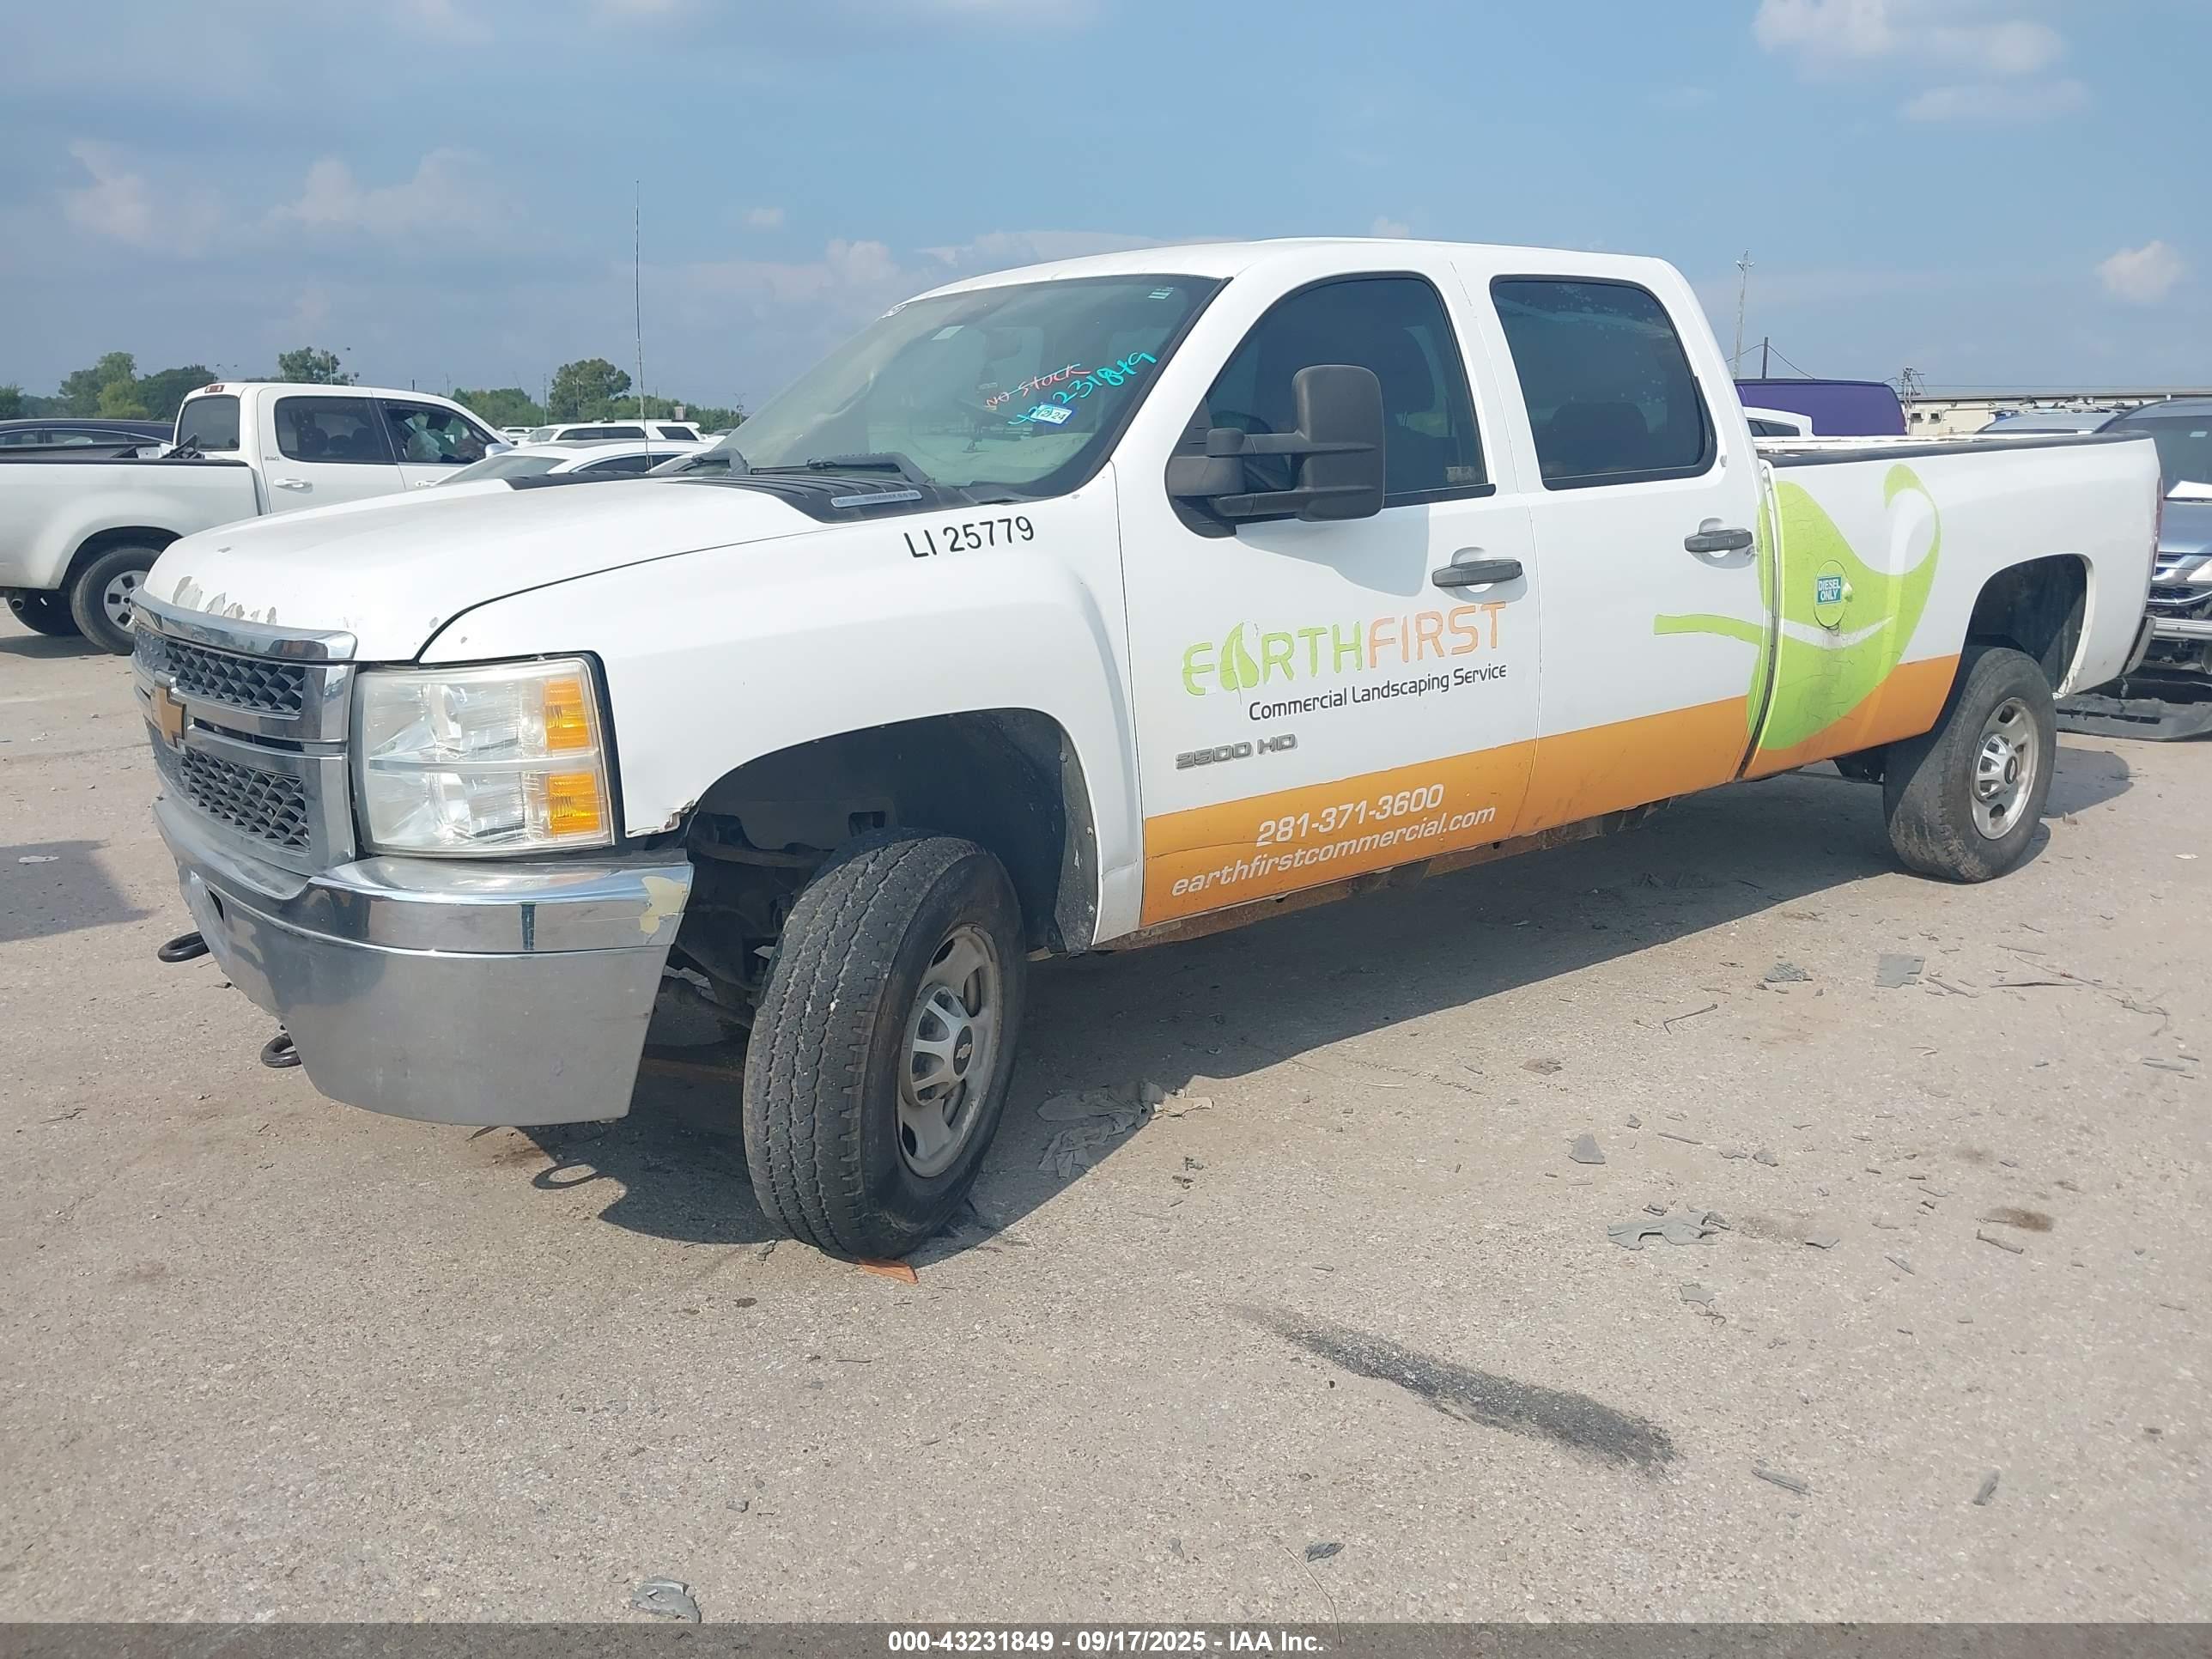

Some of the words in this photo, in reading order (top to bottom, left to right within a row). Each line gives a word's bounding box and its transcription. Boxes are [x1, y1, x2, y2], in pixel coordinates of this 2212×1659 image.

[943, 516, 1034, 552] 25779
[1818, 579, 1841, 591] DIESEL
[1820, 589, 1838, 601] ONLY
[1249, 688, 1347, 721] Commercial
[1352, 673, 1450, 703] Landscaping
[1454, 663, 1508, 687] Service
[1176, 742, 1254, 769] 2500
[1257, 734, 1296, 755] HD
[1255, 783, 1445, 848] 281-371-3600
[1170, 805, 1497, 897] earthfirstcommercial.com
